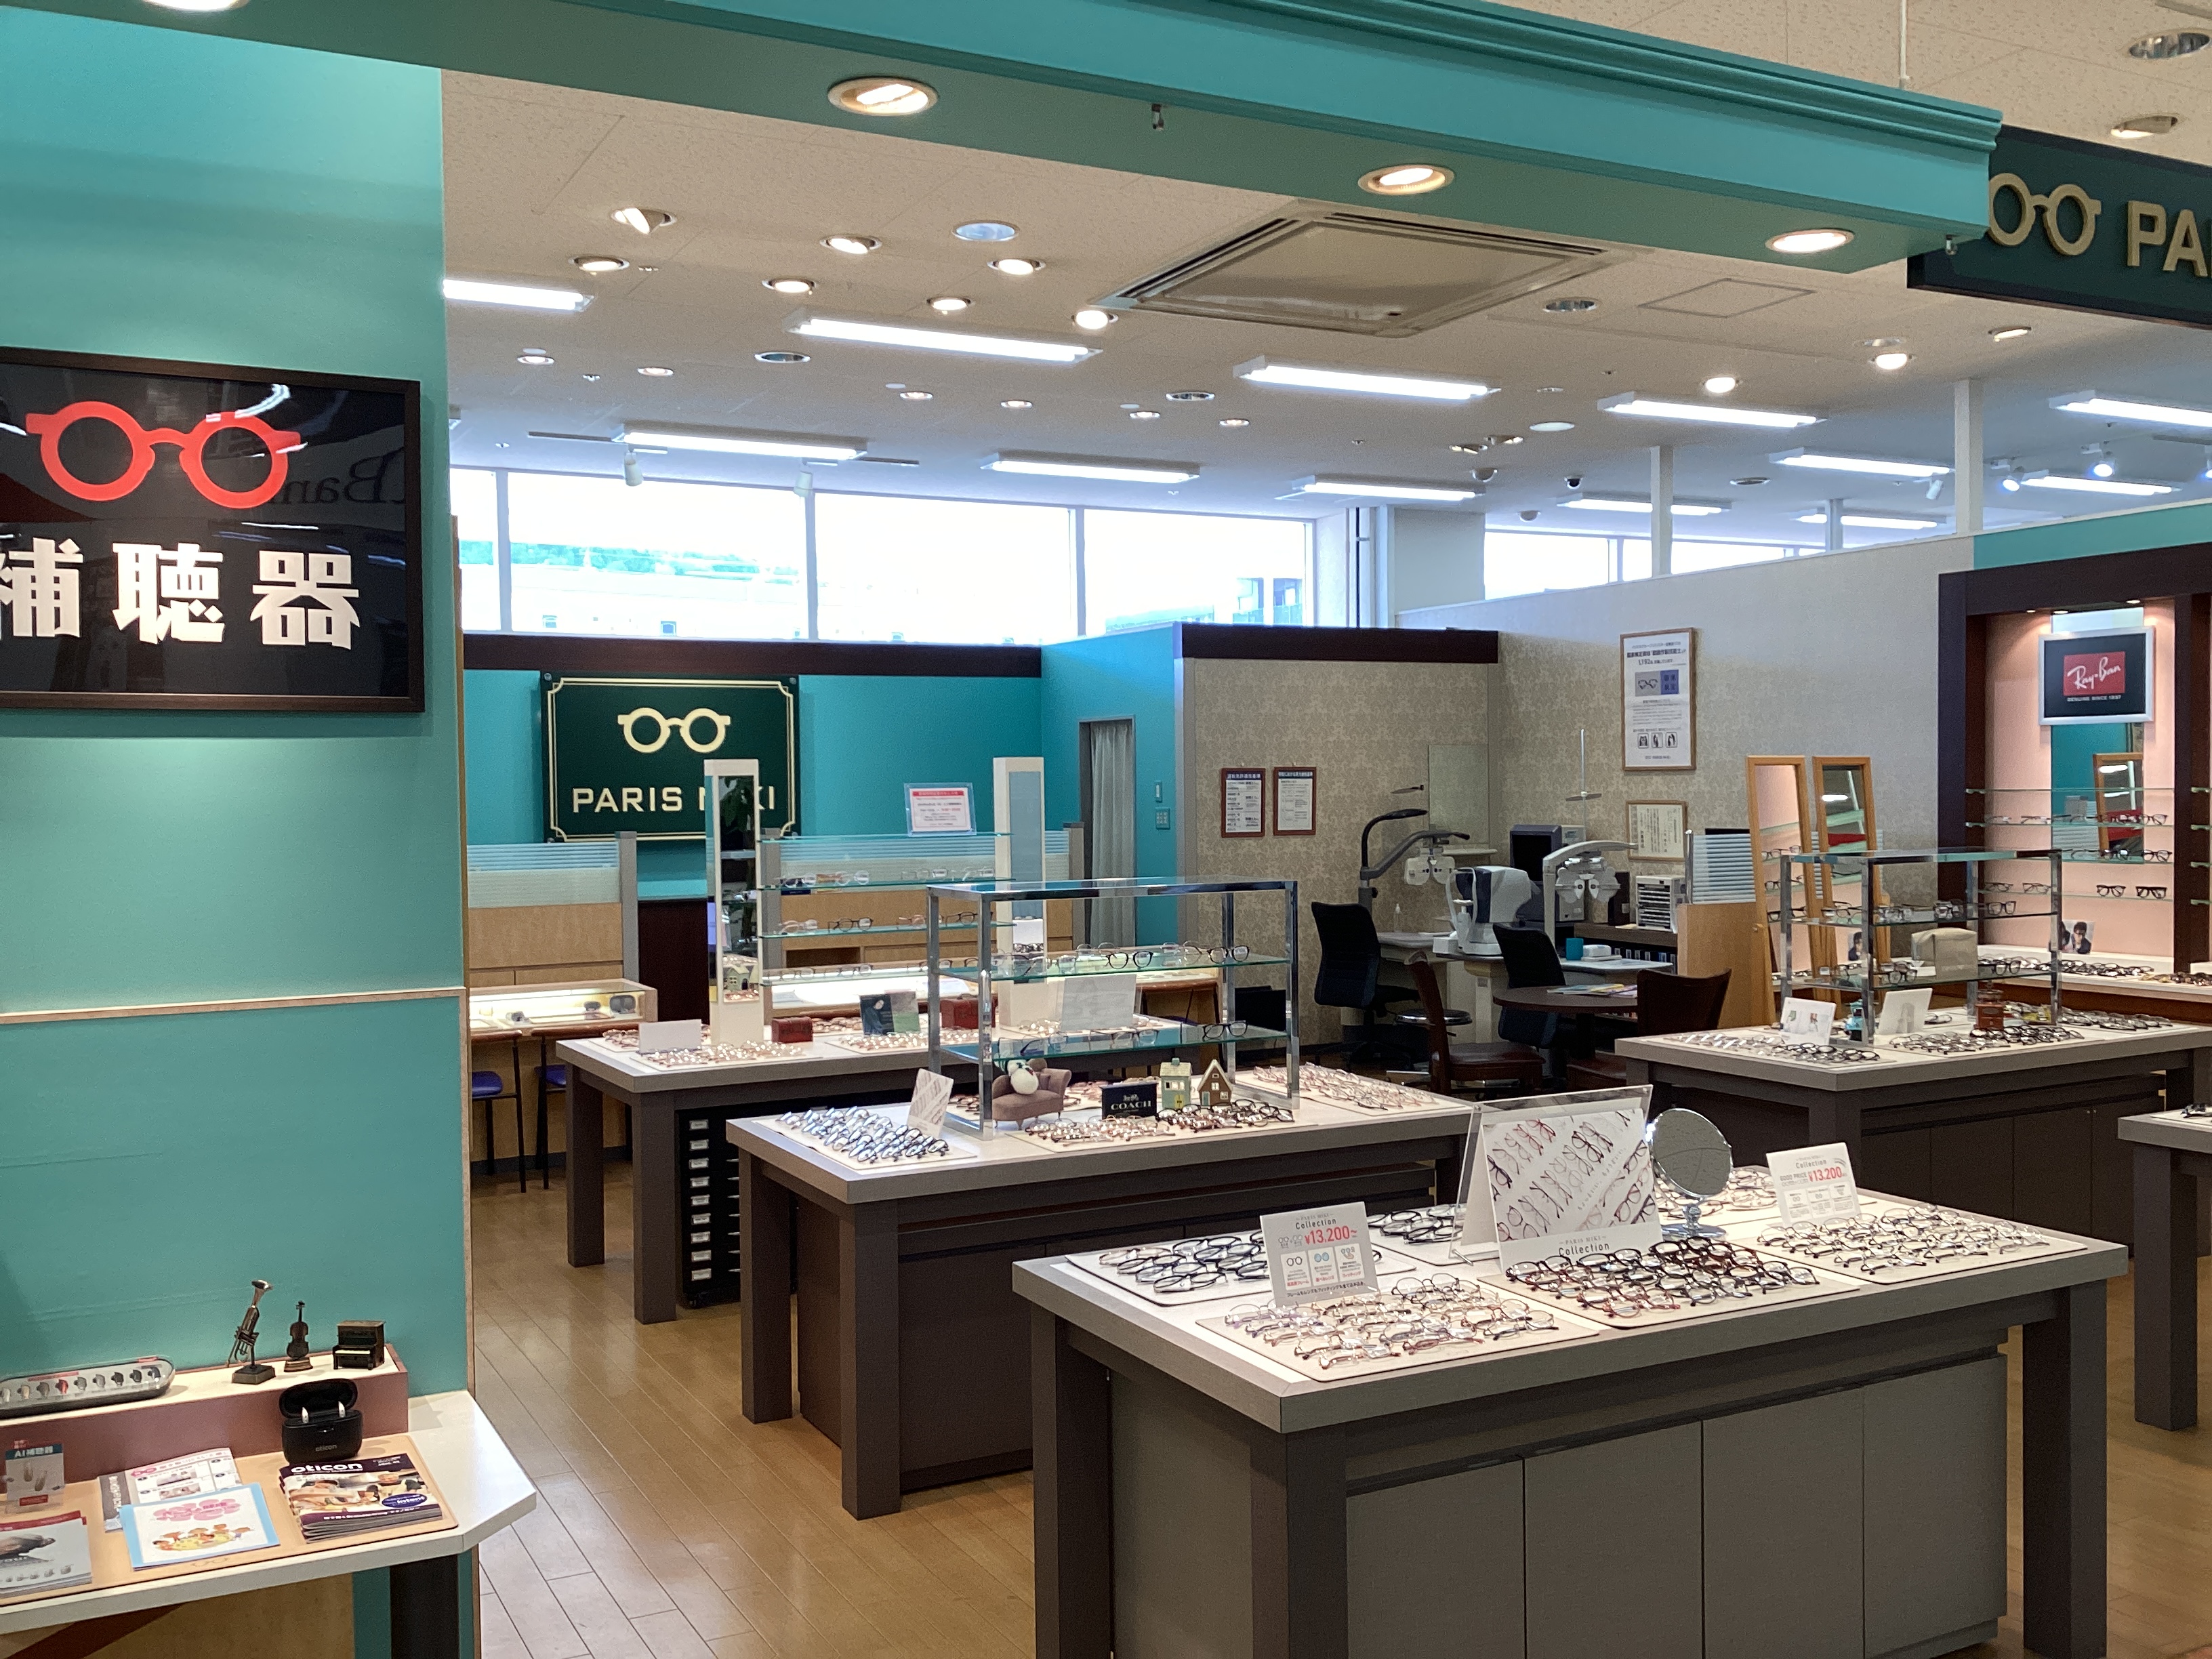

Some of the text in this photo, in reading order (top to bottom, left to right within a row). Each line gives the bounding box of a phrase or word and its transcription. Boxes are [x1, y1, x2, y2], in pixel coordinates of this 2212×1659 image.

[2127, 200, 2212, 279] PA
[0, 537, 360, 649] 補聴器
[573, 787, 683, 813] PARIS
[1111, 1101, 1151, 1110] COACH
[1295, 1218, 1336, 1230] Collection
[1559, 1242, 1610, 1256] Collection
[291, 1463, 363, 1473] oticon
